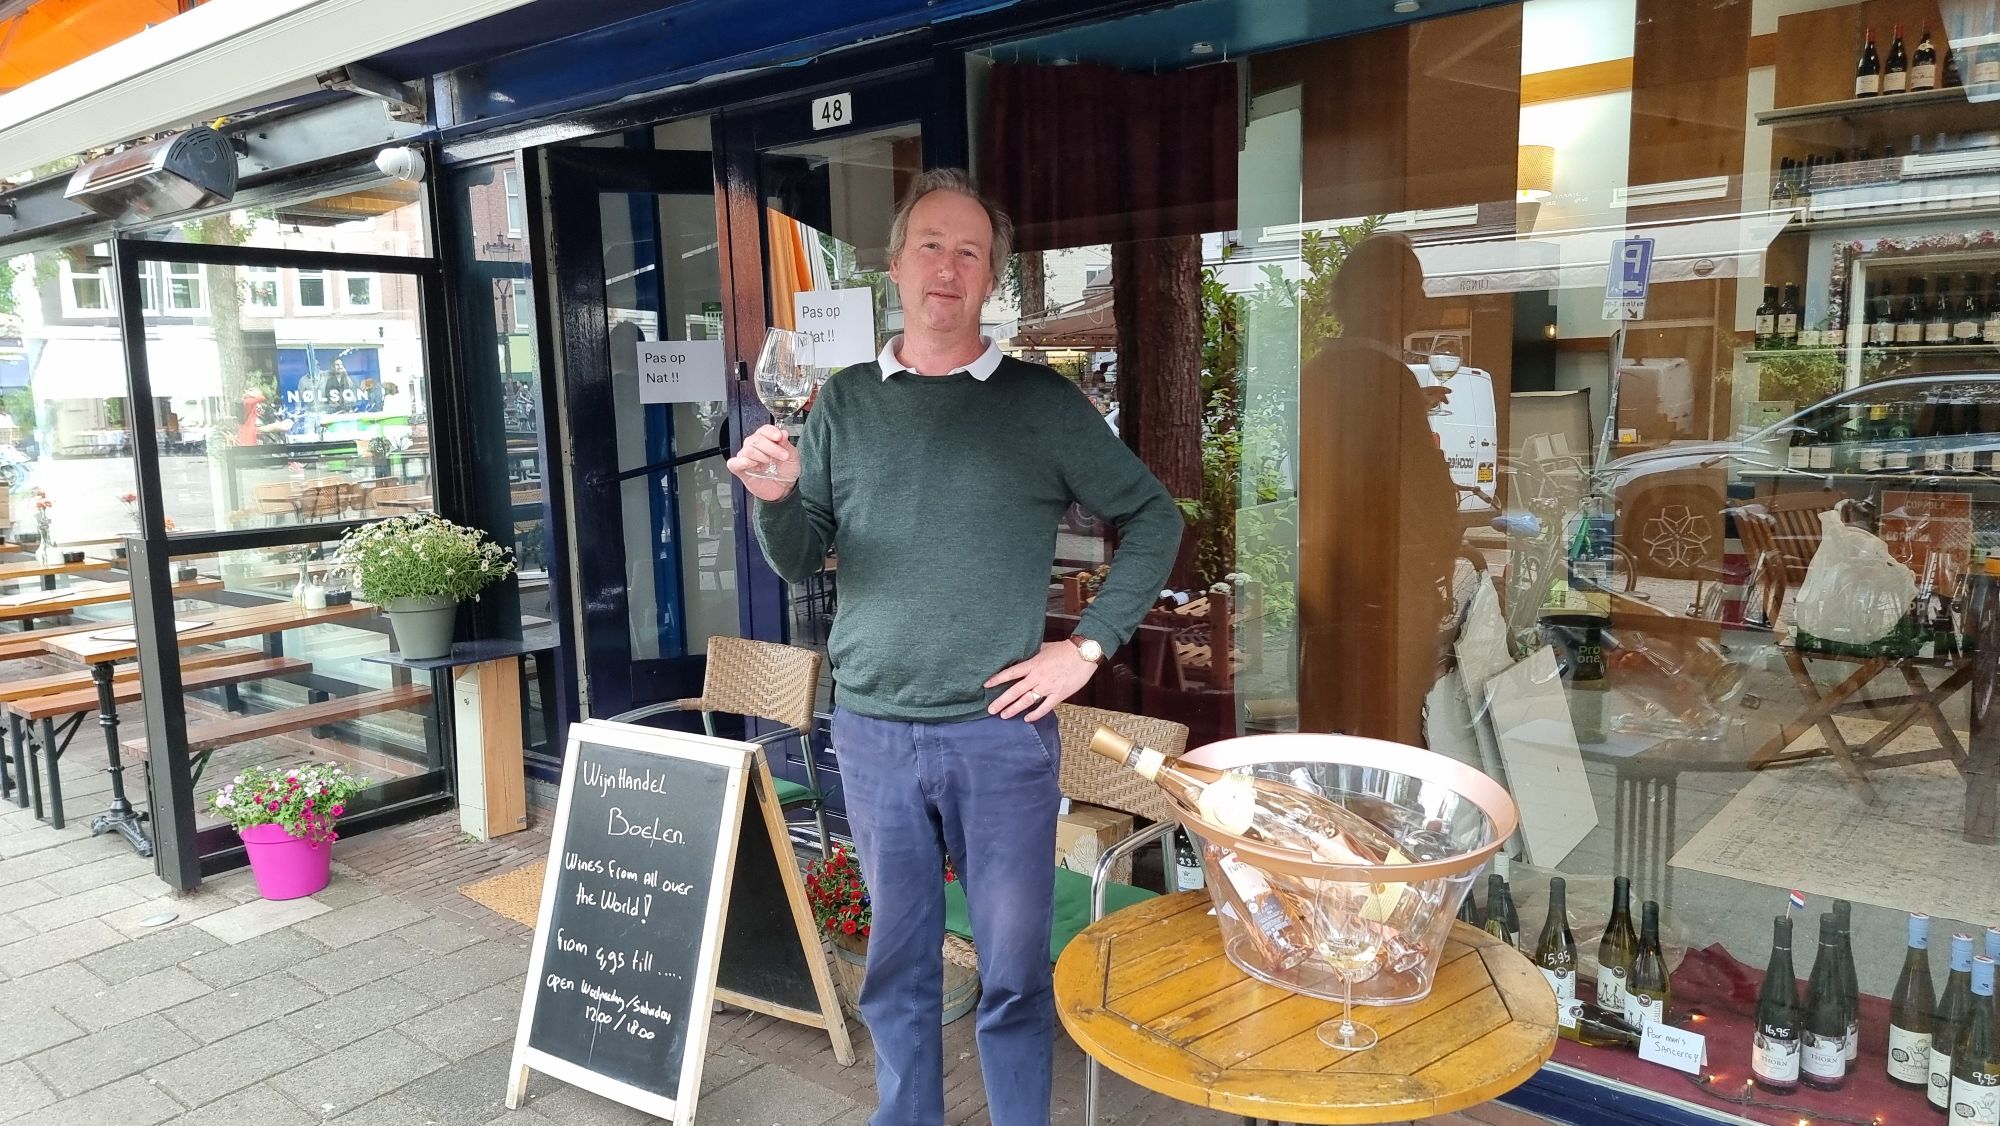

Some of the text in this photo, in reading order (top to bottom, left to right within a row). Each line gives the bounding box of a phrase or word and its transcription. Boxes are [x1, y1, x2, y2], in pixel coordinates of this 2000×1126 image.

[821, 100, 843, 123] 48
[802, 306, 840, 320] Pas op
[645, 352, 686, 365] Pas op
[646, 372, 668, 384] Nat
[1579, 645, 1601, 655] Pro
[1577, 654, 1601, 664] one
[565, 852, 604, 874] Wines
[662, 880, 694, 895] over
[576, 882, 597, 905] the
[632, 949, 653, 972] till
[1543, 950, 1571, 965] 15,95
[1765, 1024, 1791, 1037] 16,95
[1761, 1055, 1788, 1067] THORN
[1811, 1053, 1838, 1064] THORN
[1972, 1071, 1999, 1086] 9,95
